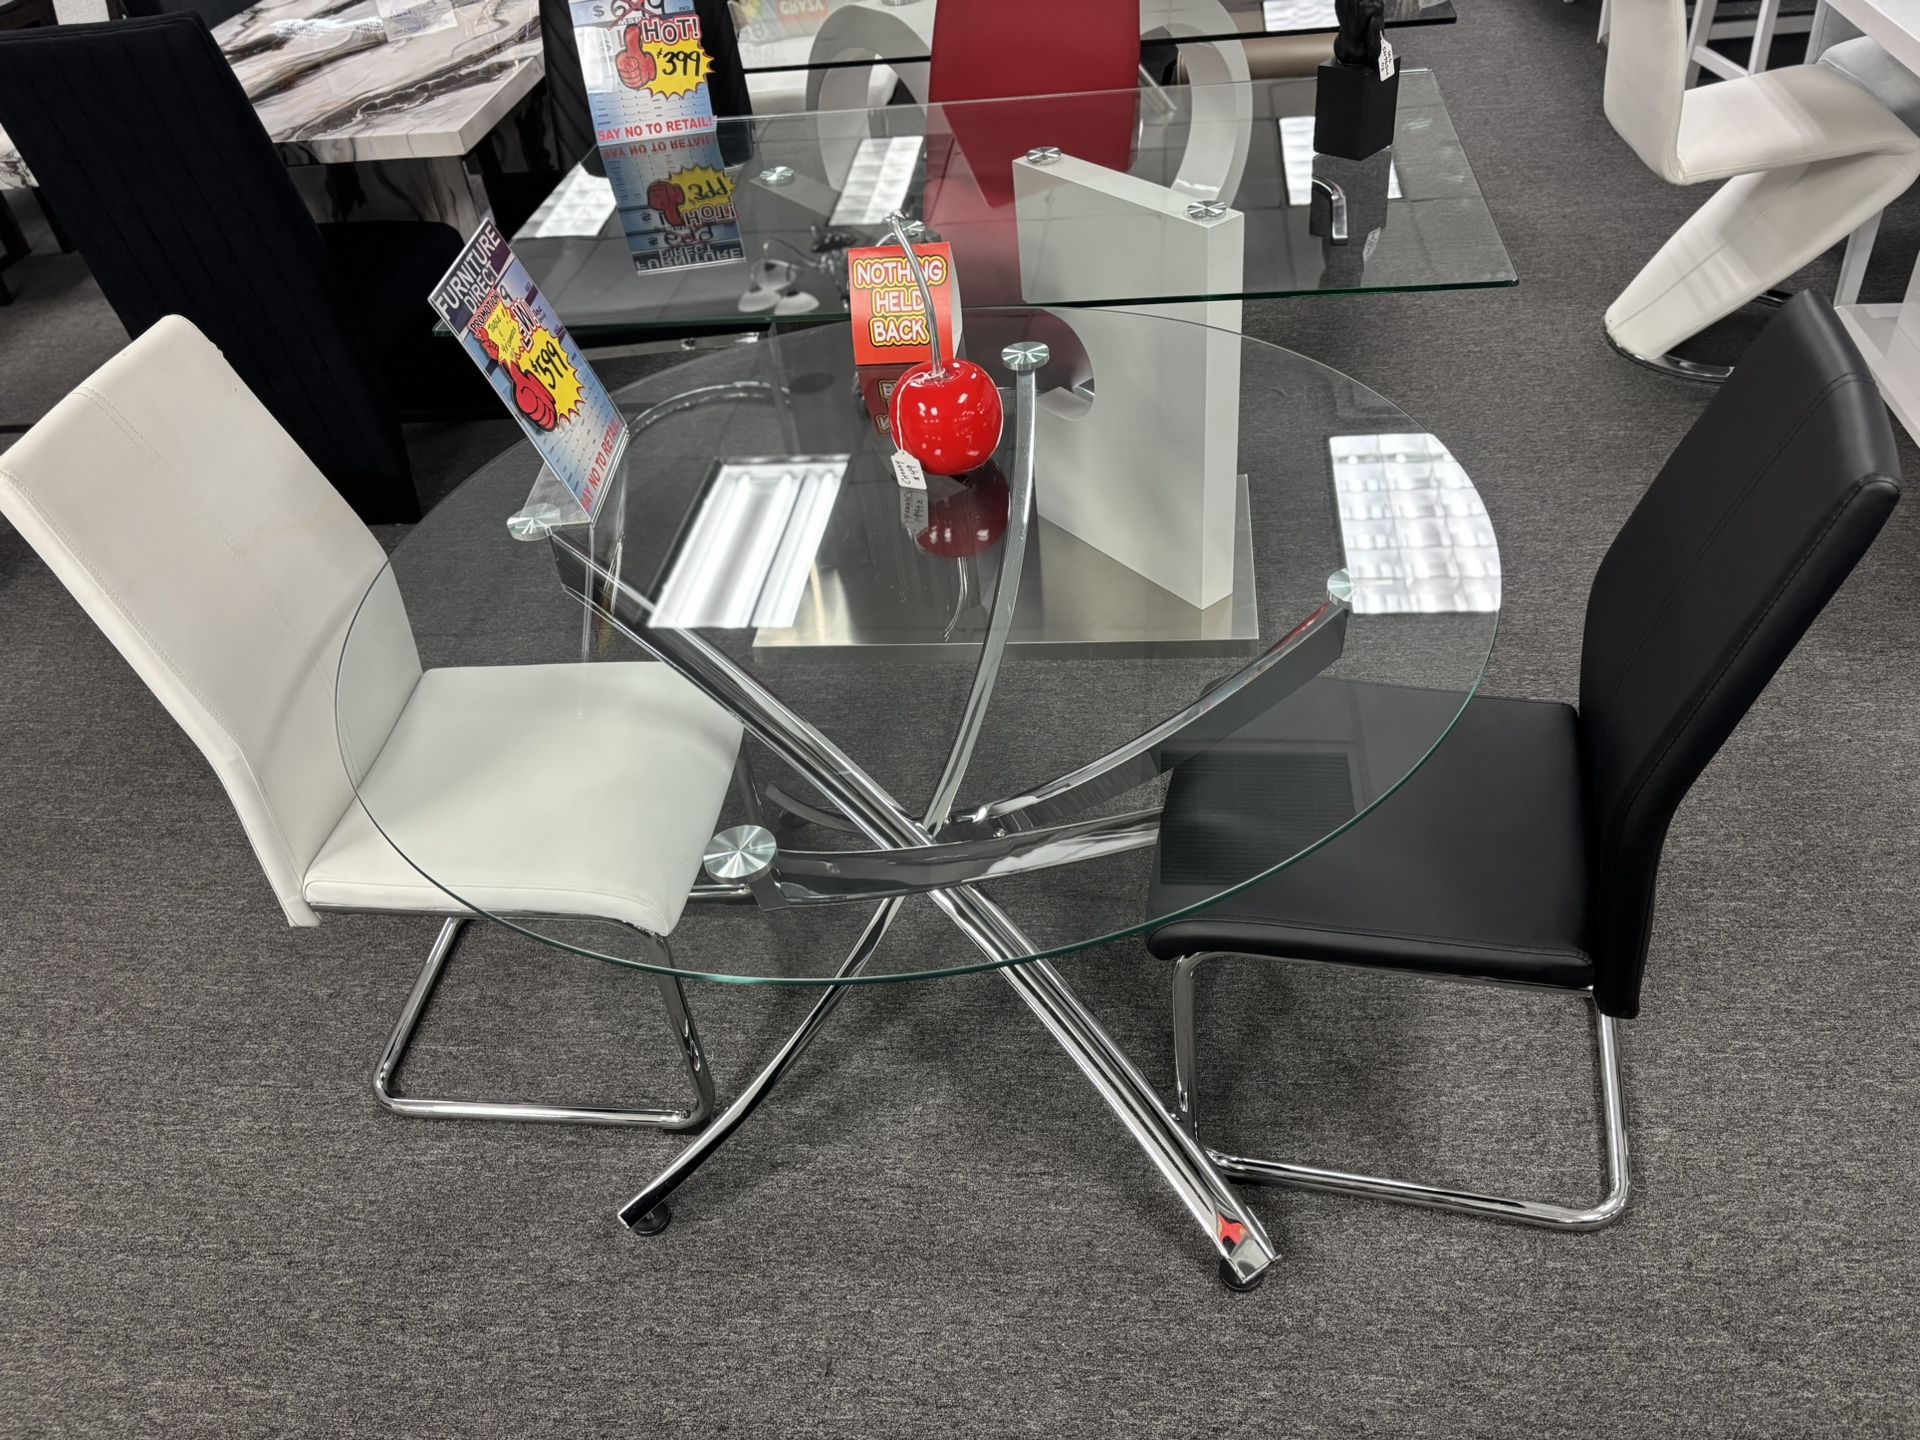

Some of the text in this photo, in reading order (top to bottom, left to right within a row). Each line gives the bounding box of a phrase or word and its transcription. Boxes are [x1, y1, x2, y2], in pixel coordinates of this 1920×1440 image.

[642, 18, 699, 44] HOT!
[597, 116, 713, 142] SAY NO TO RETAIL!
[435, 224, 501, 320] FURNITURE
[463, 262, 499, 314] DIRECT
[470, 292, 500, 333] PROMOTION
[875, 290, 925, 312] HELD
[873, 319, 927, 342] BACK
[531, 340, 569, 389] $599
[588, 468, 599, 490] NO
[595, 452, 606, 472] TO
